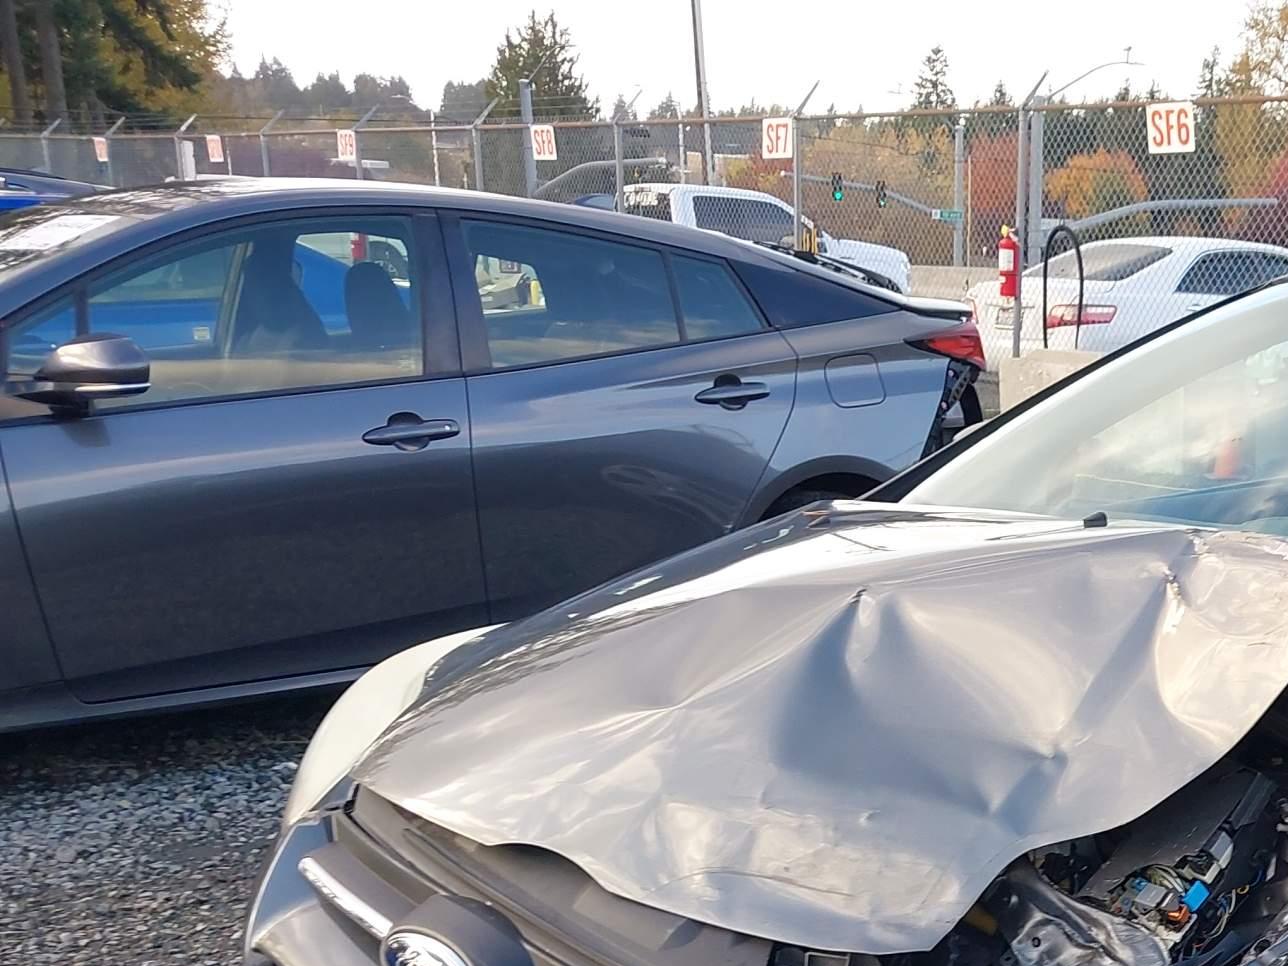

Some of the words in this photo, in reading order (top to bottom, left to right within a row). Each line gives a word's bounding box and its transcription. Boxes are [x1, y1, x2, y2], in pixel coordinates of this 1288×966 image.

[533, 129, 554, 156] SF8
[766, 122, 788, 154] SF7
[1151, 107, 1190, 147] SF6
